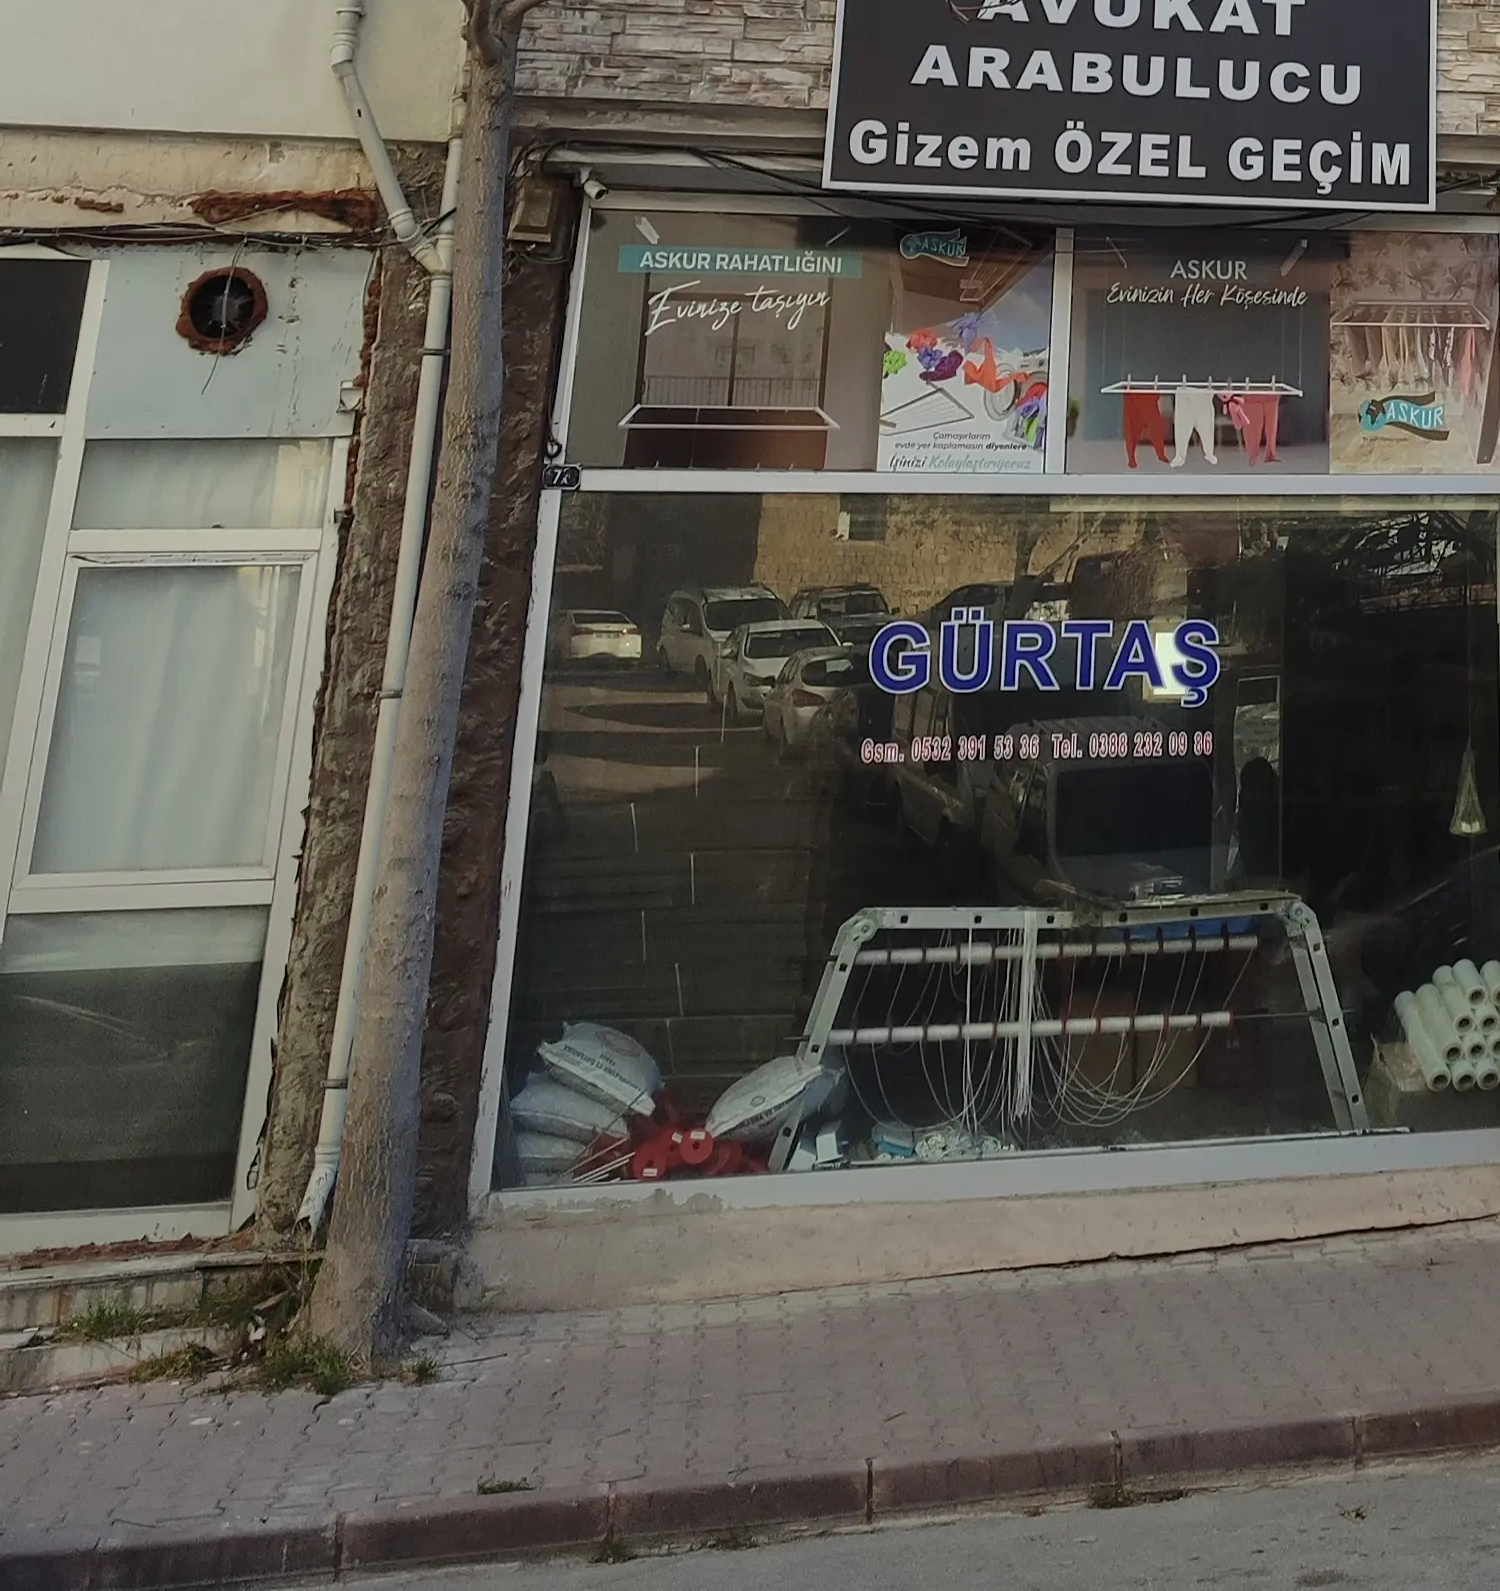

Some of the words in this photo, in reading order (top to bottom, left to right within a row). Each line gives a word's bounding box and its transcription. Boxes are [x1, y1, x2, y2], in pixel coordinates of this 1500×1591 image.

[910, 44, 1362, 105] ARABULUCU
[848, 119, 1031, 170] Gizem
[1054, 121, 1206, 178] ÖZEL
[1228, 131, 1410, 194] GEÇİM
[639, 251, 710, 270] ASKUR
[716, 250, 842, 274] RAHATLIĞINI
[1170, 260, 1247, 280] ASKUR
[644, 280, 742, 336] Evinize
[744, 285, 832, 330] taşıyın
[1106, 282, 1174, 304] Evinizin
[1181, 283, 1215, 307] Her
[1220, 283, 1308, 310] Köşesinde
[1386, 402, 1444, 428] ASKUR
[868, 607, 1221, 707] GÜRTAŞ
[861, 737, 904, 764] Gsm.
[911, 735, 952, 762] 0532
[957, 735, 987, 761] 391
[994, 734, 1014, 760] 53
[1020, 733, 1040, 759] 36
[1052, 733, 1083, 759] Tel.
[1089, 732, 1128, 758] 0388
[1133, 732, 1163, 757] 232
[1168, 731, 1188, 756] 09
[1193, 730, 1213, 756] 86
